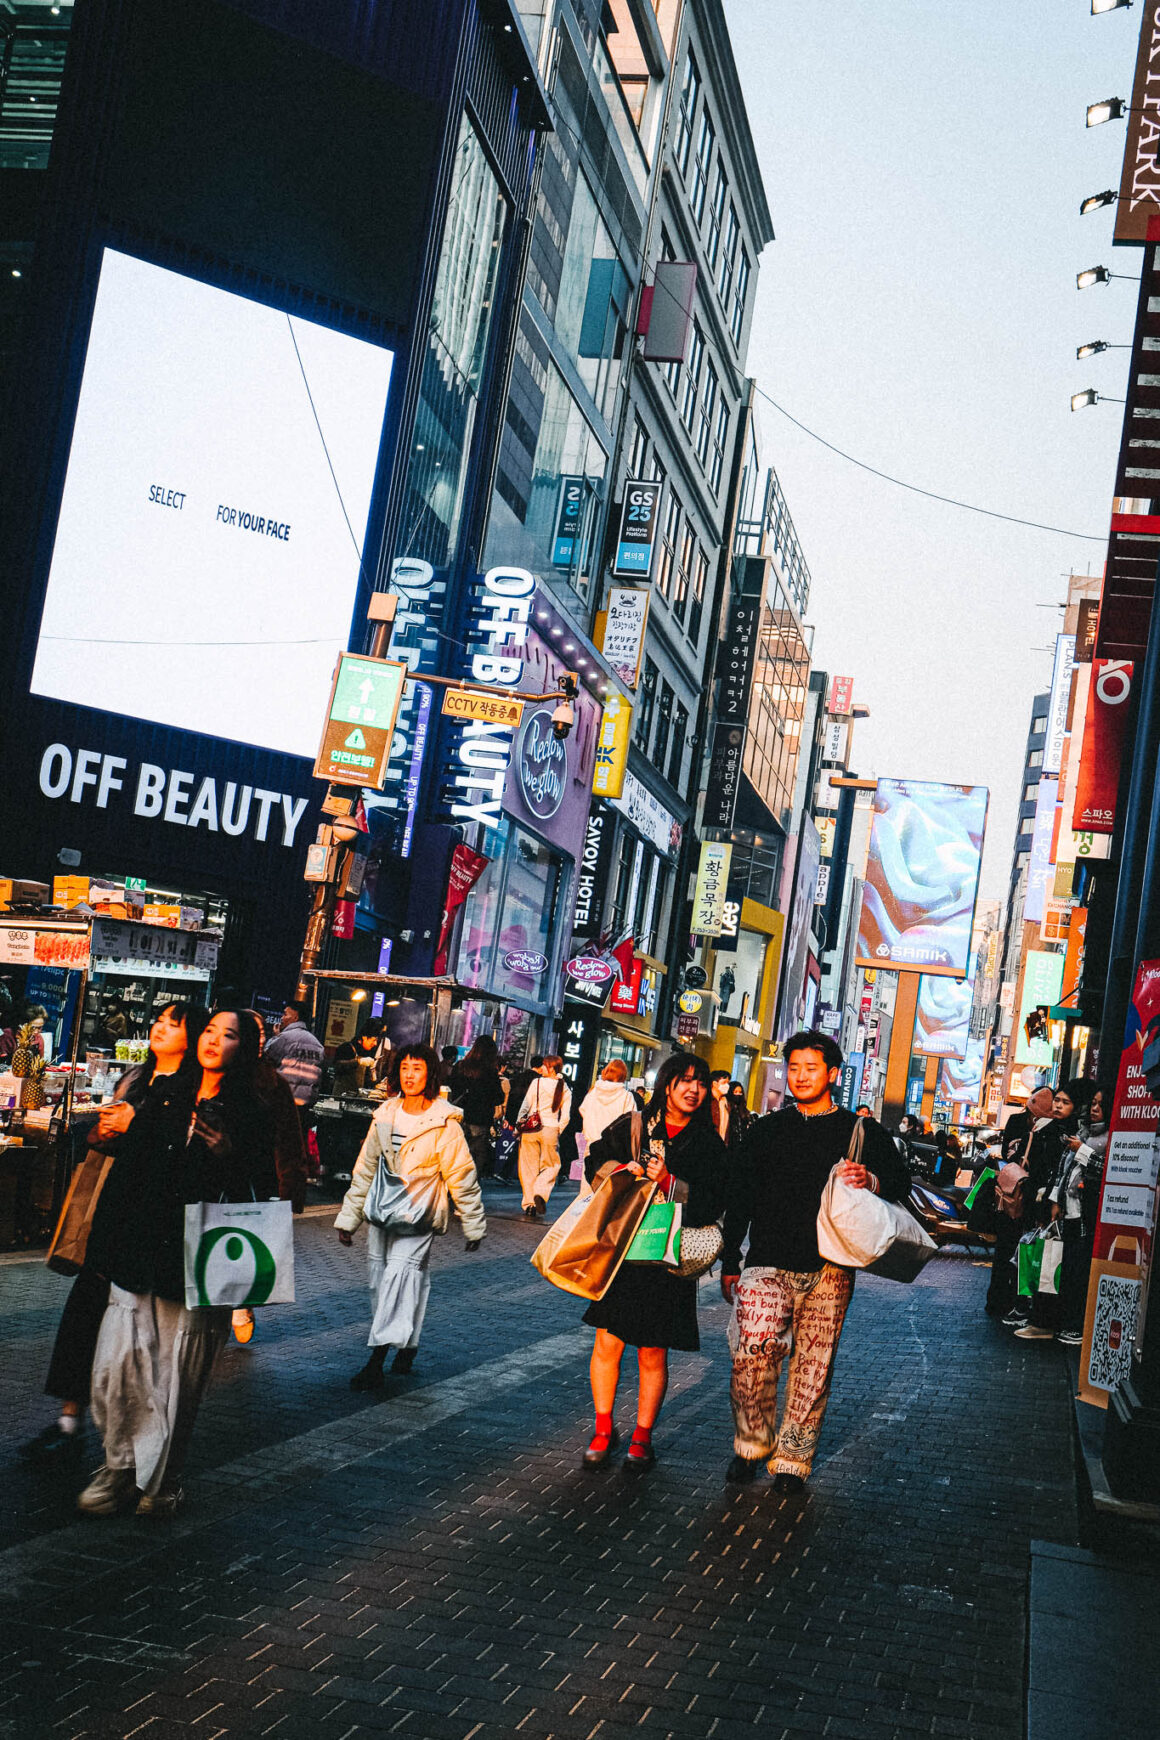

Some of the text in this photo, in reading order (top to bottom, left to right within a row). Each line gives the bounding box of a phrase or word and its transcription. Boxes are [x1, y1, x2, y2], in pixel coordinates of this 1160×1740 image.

[148, 484, 187, 511] SELECT
[629, 490, 654, 506] GS
[216, 503, 292, 543] FOR YOUR FACE
[628, 505, 652, 522] 25
[479, 565, 534, 647] OFF
[727, 609, 754, 714] 이철헤어커커 2
[446, 696, 508, 720] CCTV 작동중
[39, 742, 310, 848] OFF BEAUTY
[1081, 808, 1113, 820] 스파오
[581, 815, 604, 872] SAVOY
[573, 874, 596, 930] HOTEL
[698, 860, 723, 926] 황금목장
[890, 945, 948, 962] SAMIK
[575, 960, 606, 971] Reclow
[562, 1020, 585, 1082] 사보이
[1119, 1105, 1140, 1120] WITH
[1114, 1141, 1122, 1149] Get
[1128, 1141, 1151, 1150] additional
[1120, 1153, 1140, 1163] discount
[750, 1289, 779, 1299] name
[760, 1297, 779, 1310] but
